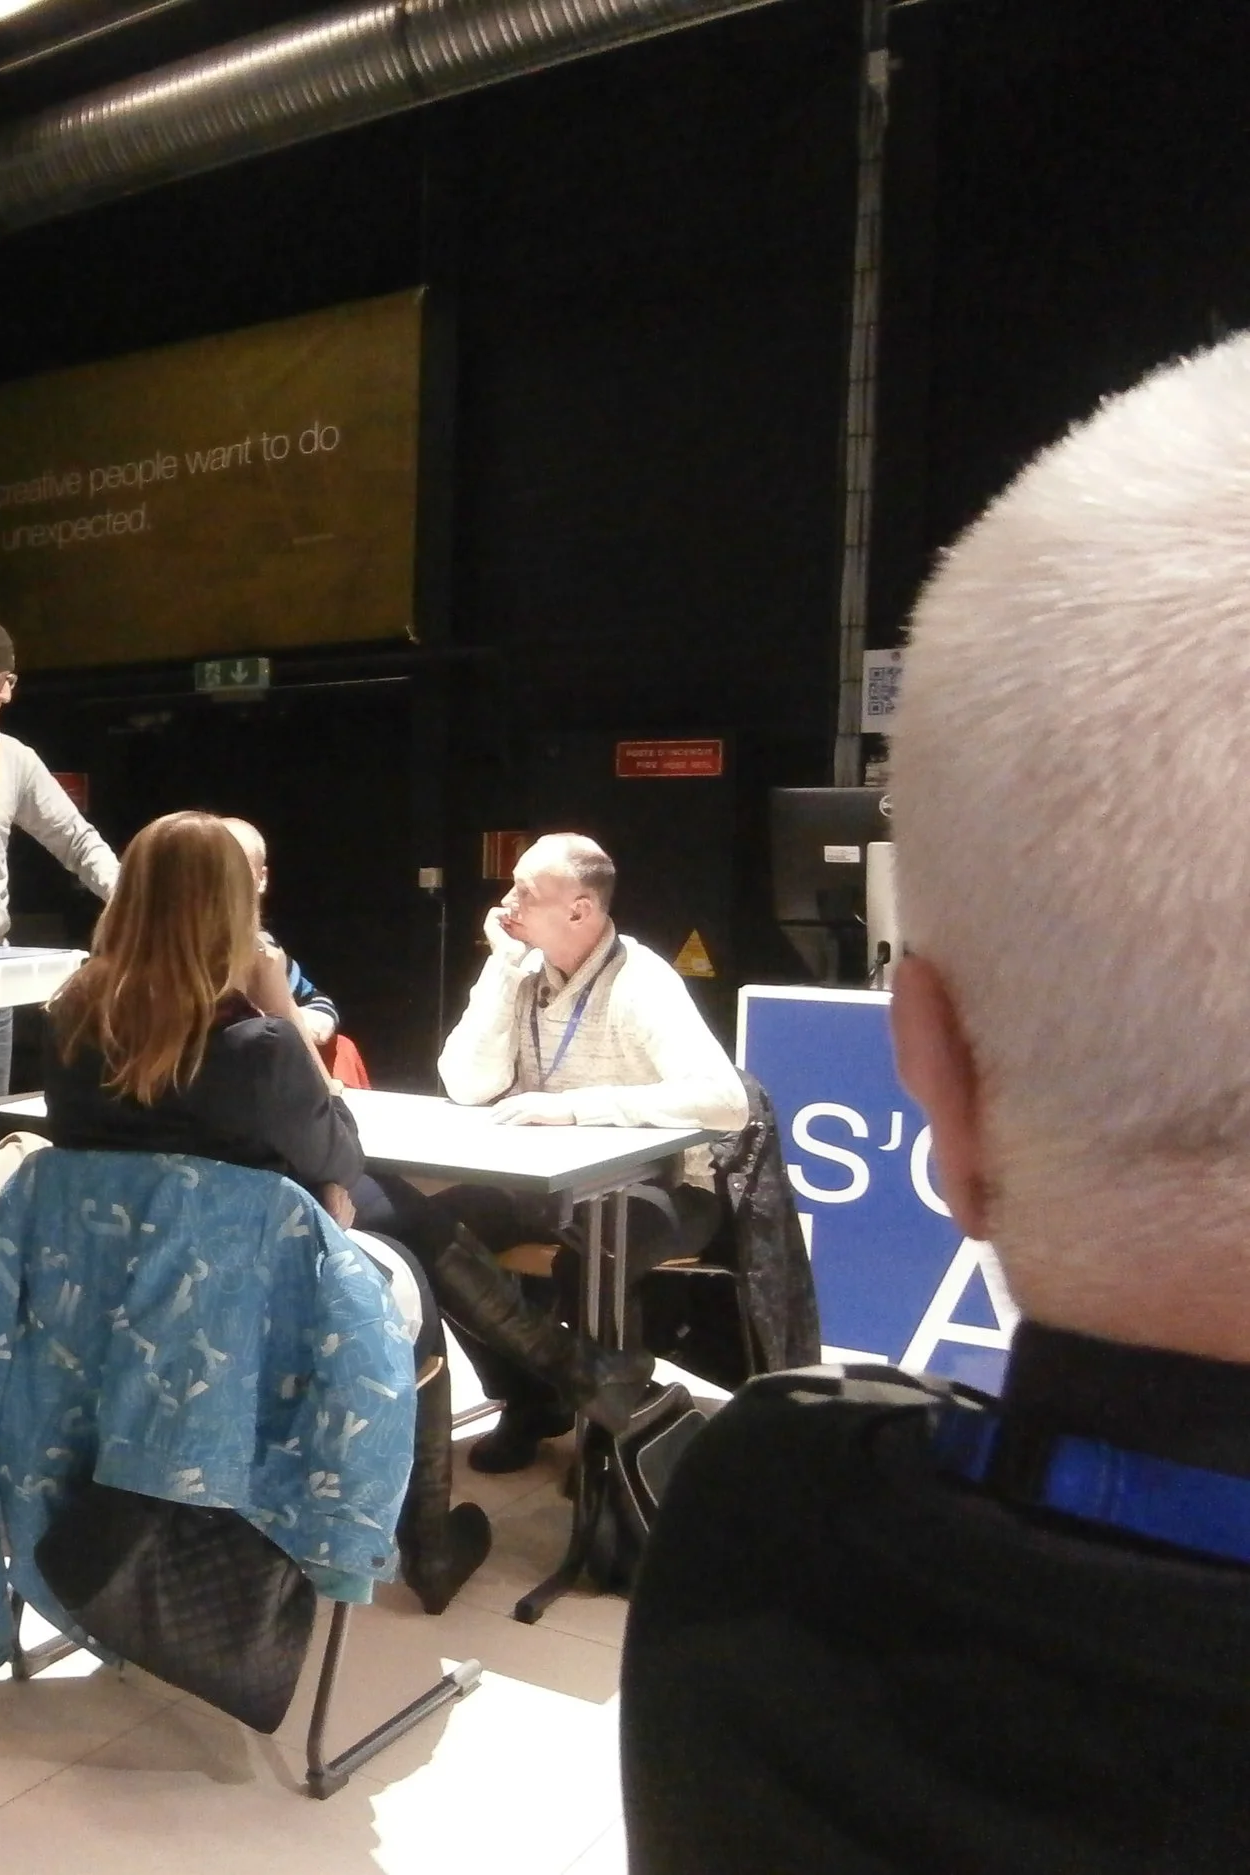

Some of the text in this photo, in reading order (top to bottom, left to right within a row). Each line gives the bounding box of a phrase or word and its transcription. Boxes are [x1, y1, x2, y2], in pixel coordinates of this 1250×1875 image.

[89, 450, 178, 496] people
[184, 435, 254, 475] want
[261, 431, 290, 461] to
[298, 420, 341, 455] do
[2, 503, 152, 550] unexpected.
